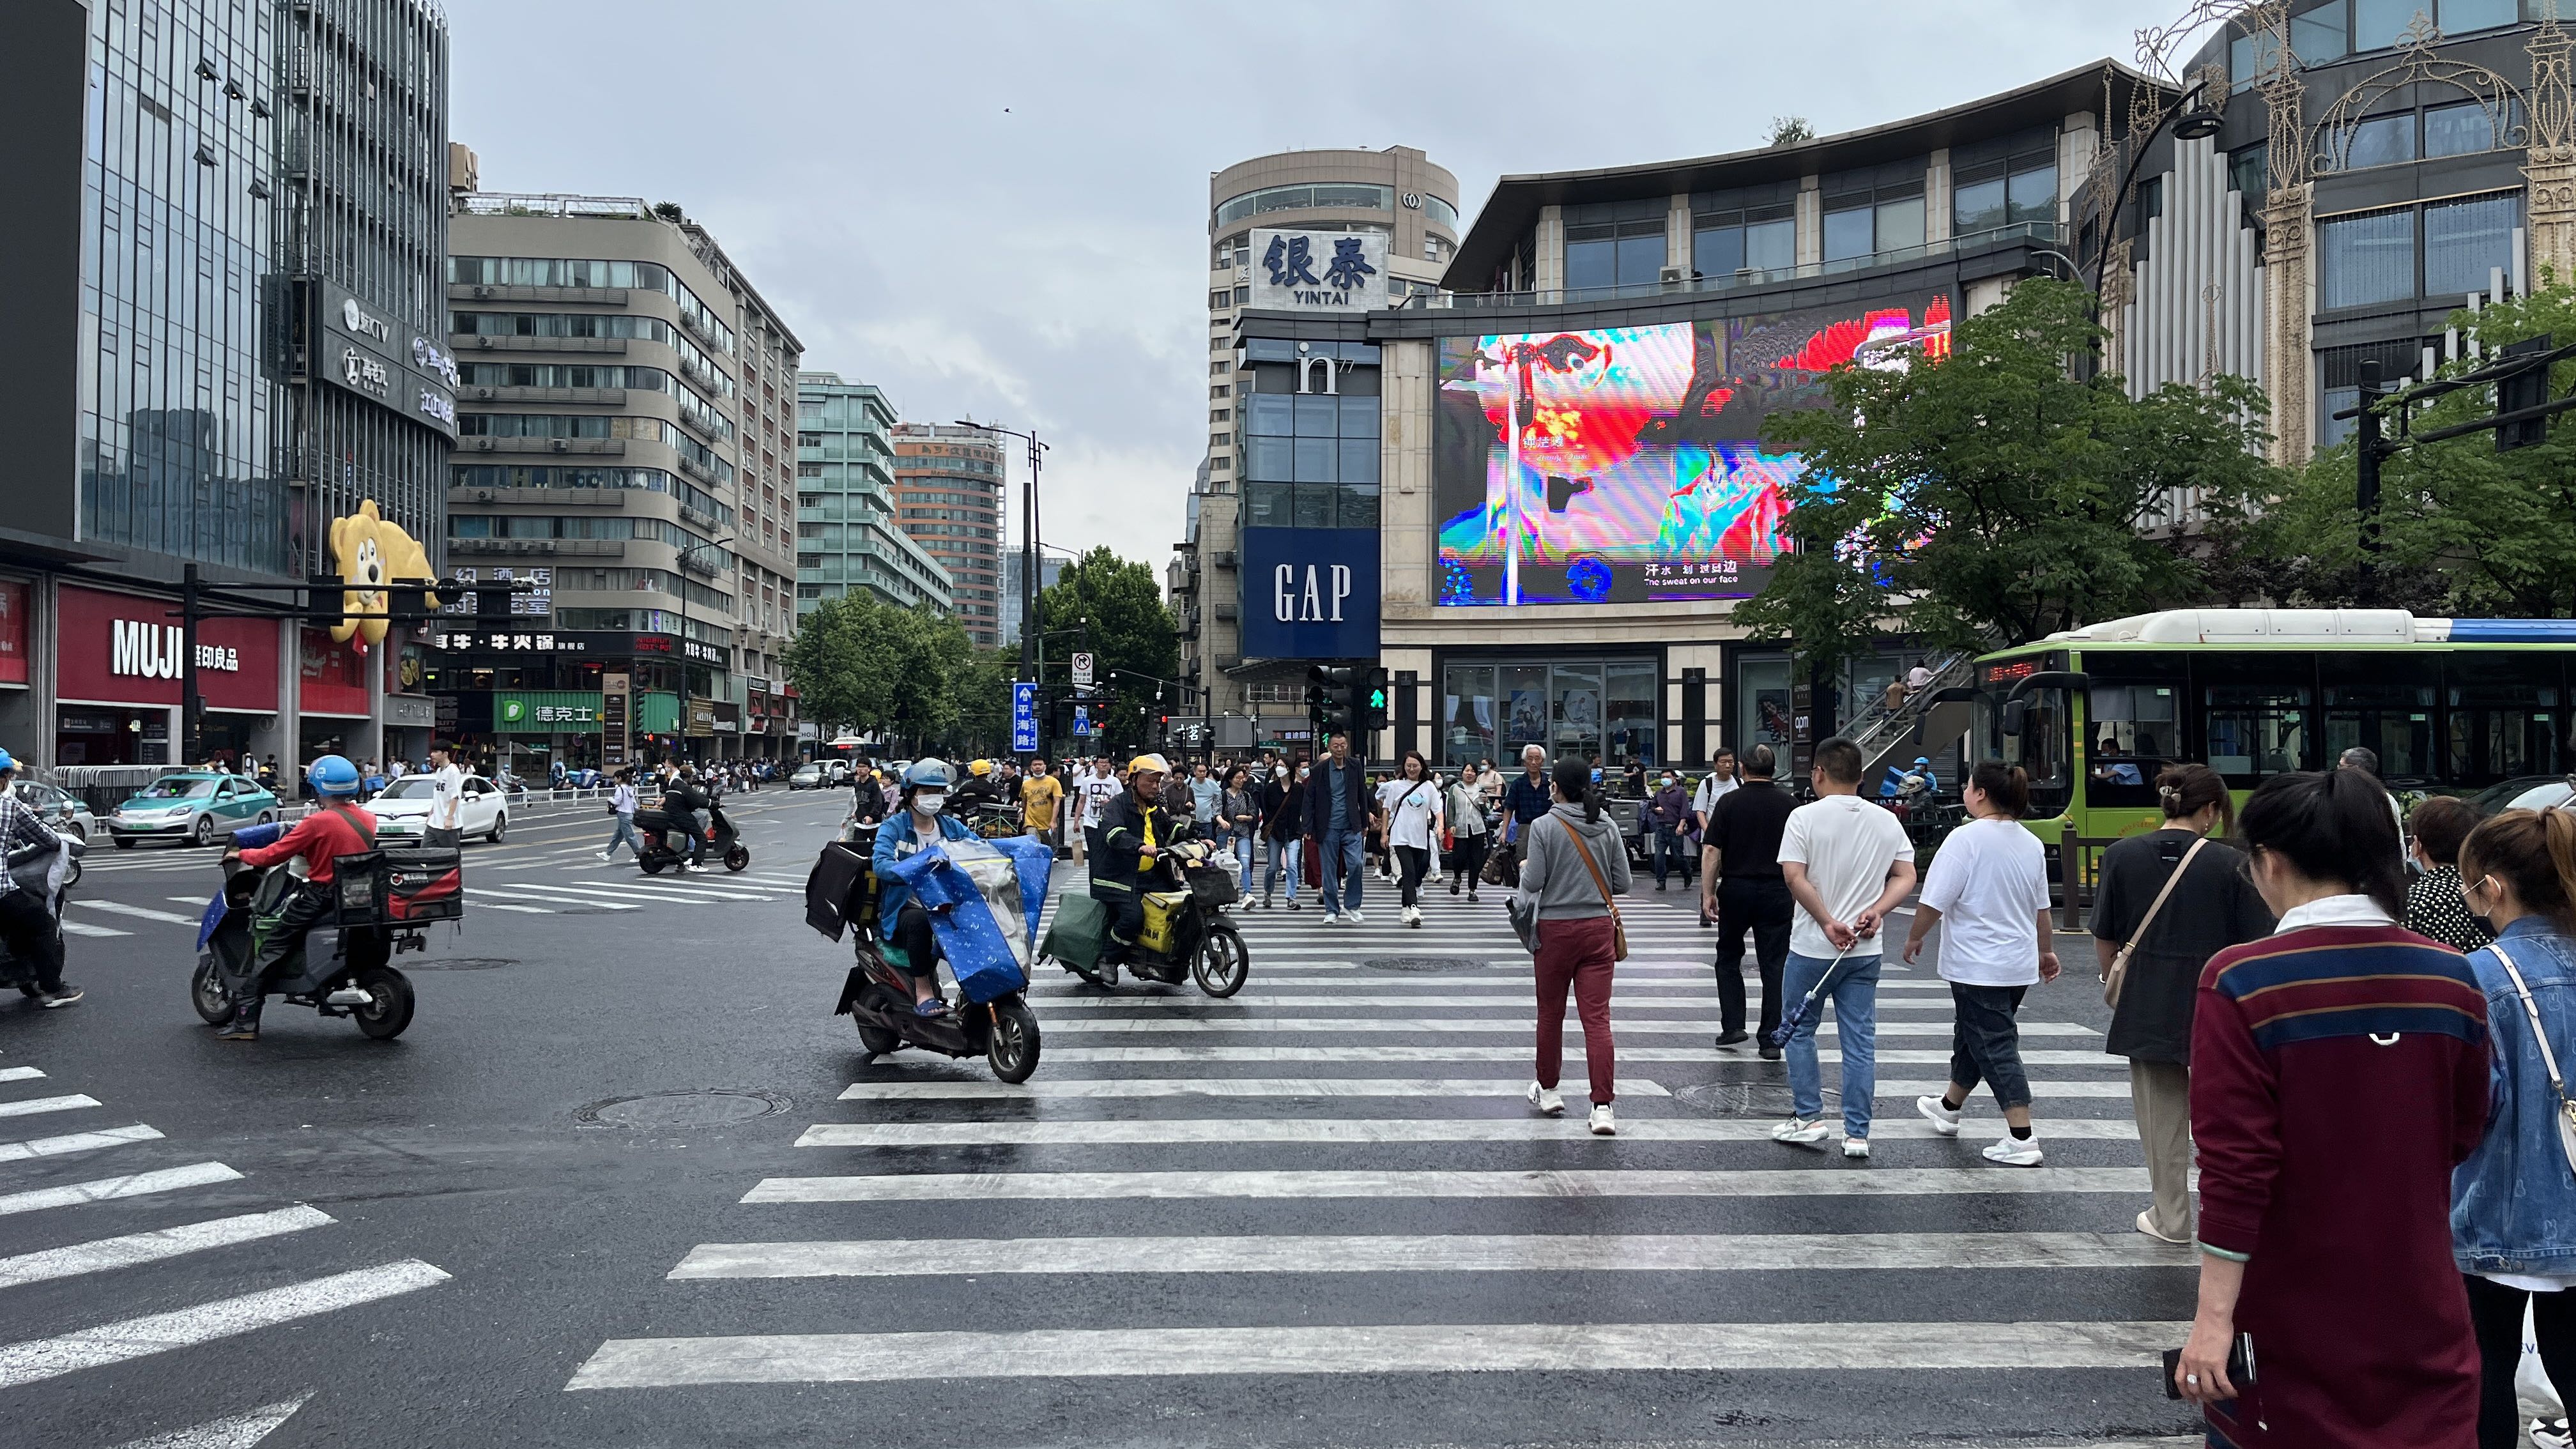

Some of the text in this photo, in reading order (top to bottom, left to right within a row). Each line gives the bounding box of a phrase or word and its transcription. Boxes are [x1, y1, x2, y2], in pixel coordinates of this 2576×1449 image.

[1262, 235, 1376, 290] 银泰
[1294, 291, 1349, 305] YINTAI
[1275, 563, 1351, 622] GAP
[1662, 578, 1688, 586] sweat
[1719, 575, 1738, 583] face
[114, 618, 183, 679] MUJI
[535, 706, 593, 722] 德克士
[1016, 705, 1030, 746] 平海路
